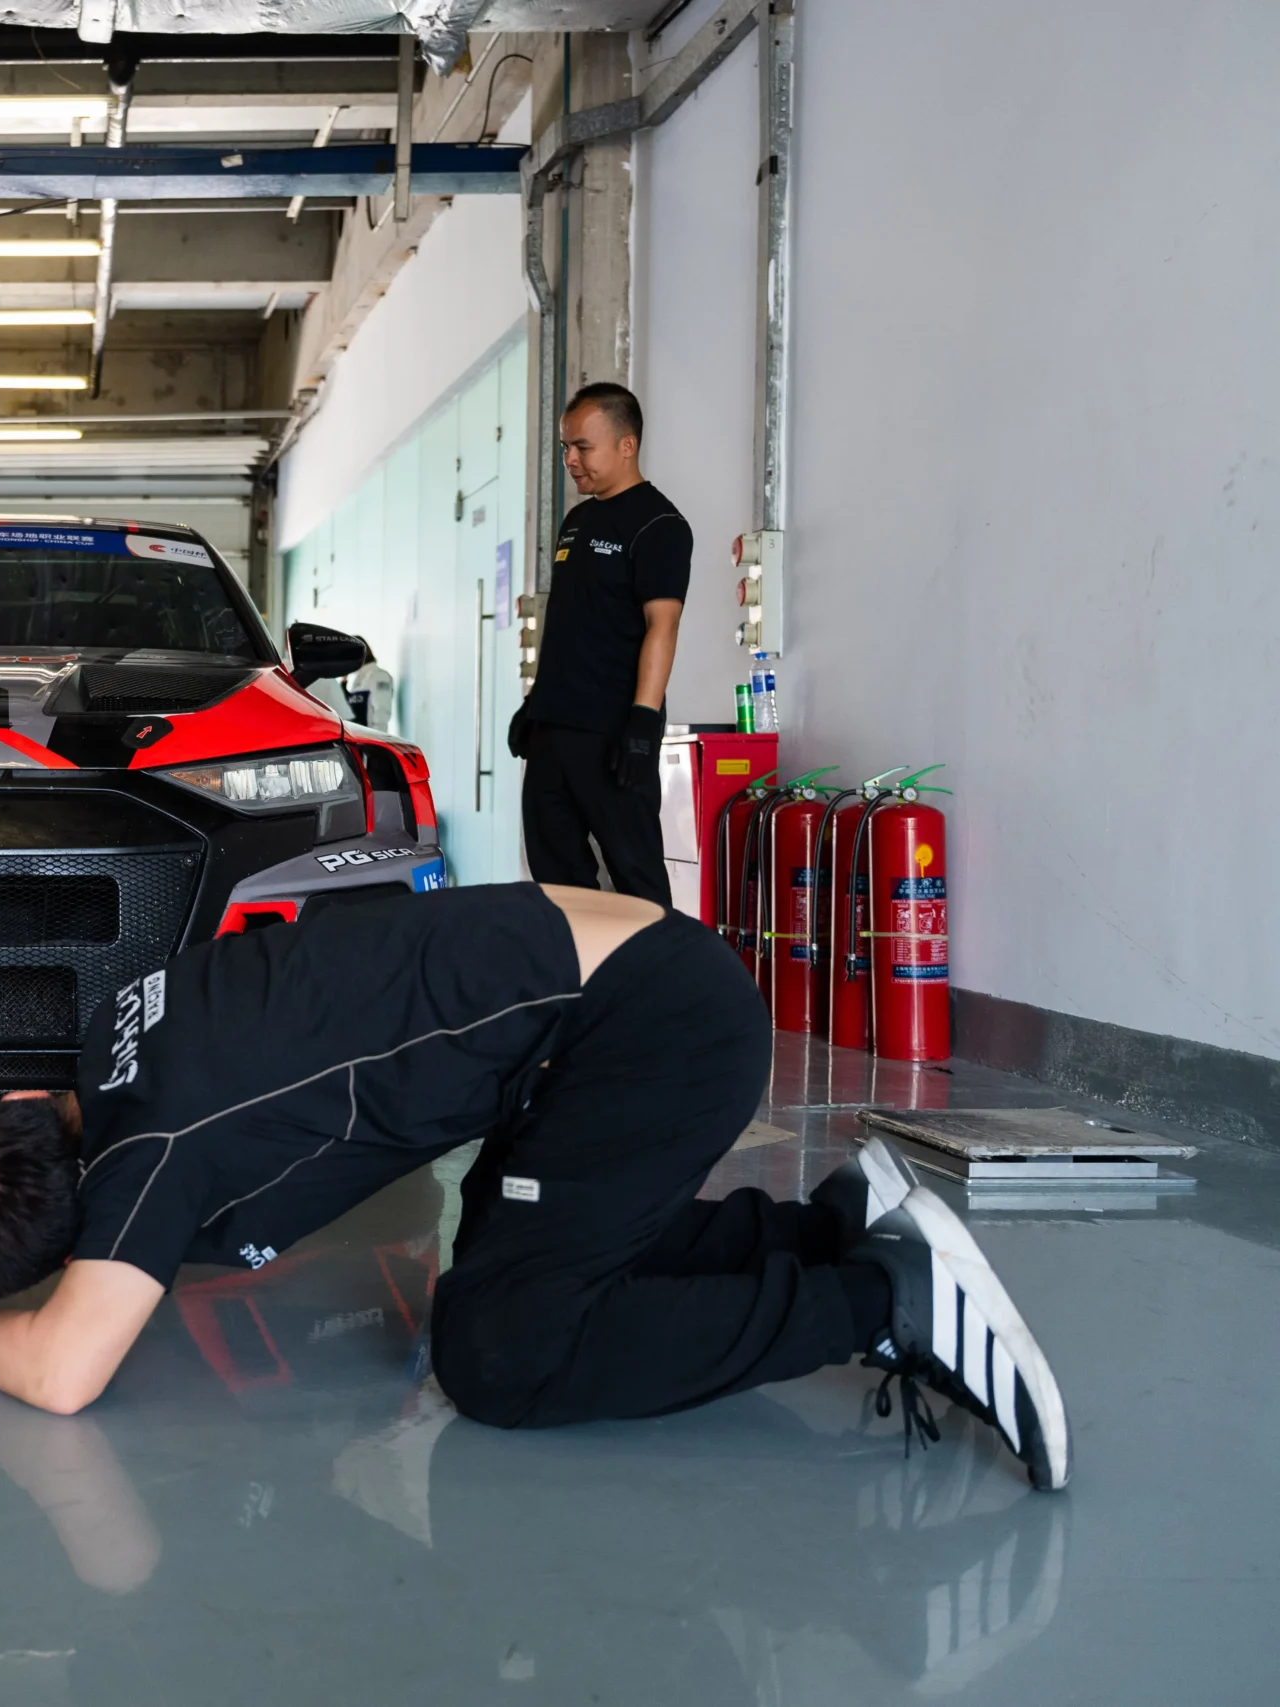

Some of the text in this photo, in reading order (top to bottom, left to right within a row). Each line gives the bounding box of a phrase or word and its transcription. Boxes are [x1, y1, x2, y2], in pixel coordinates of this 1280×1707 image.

[316, 848, 417, 873] PG SICA
[146, 975, 162, 1021] RACING
